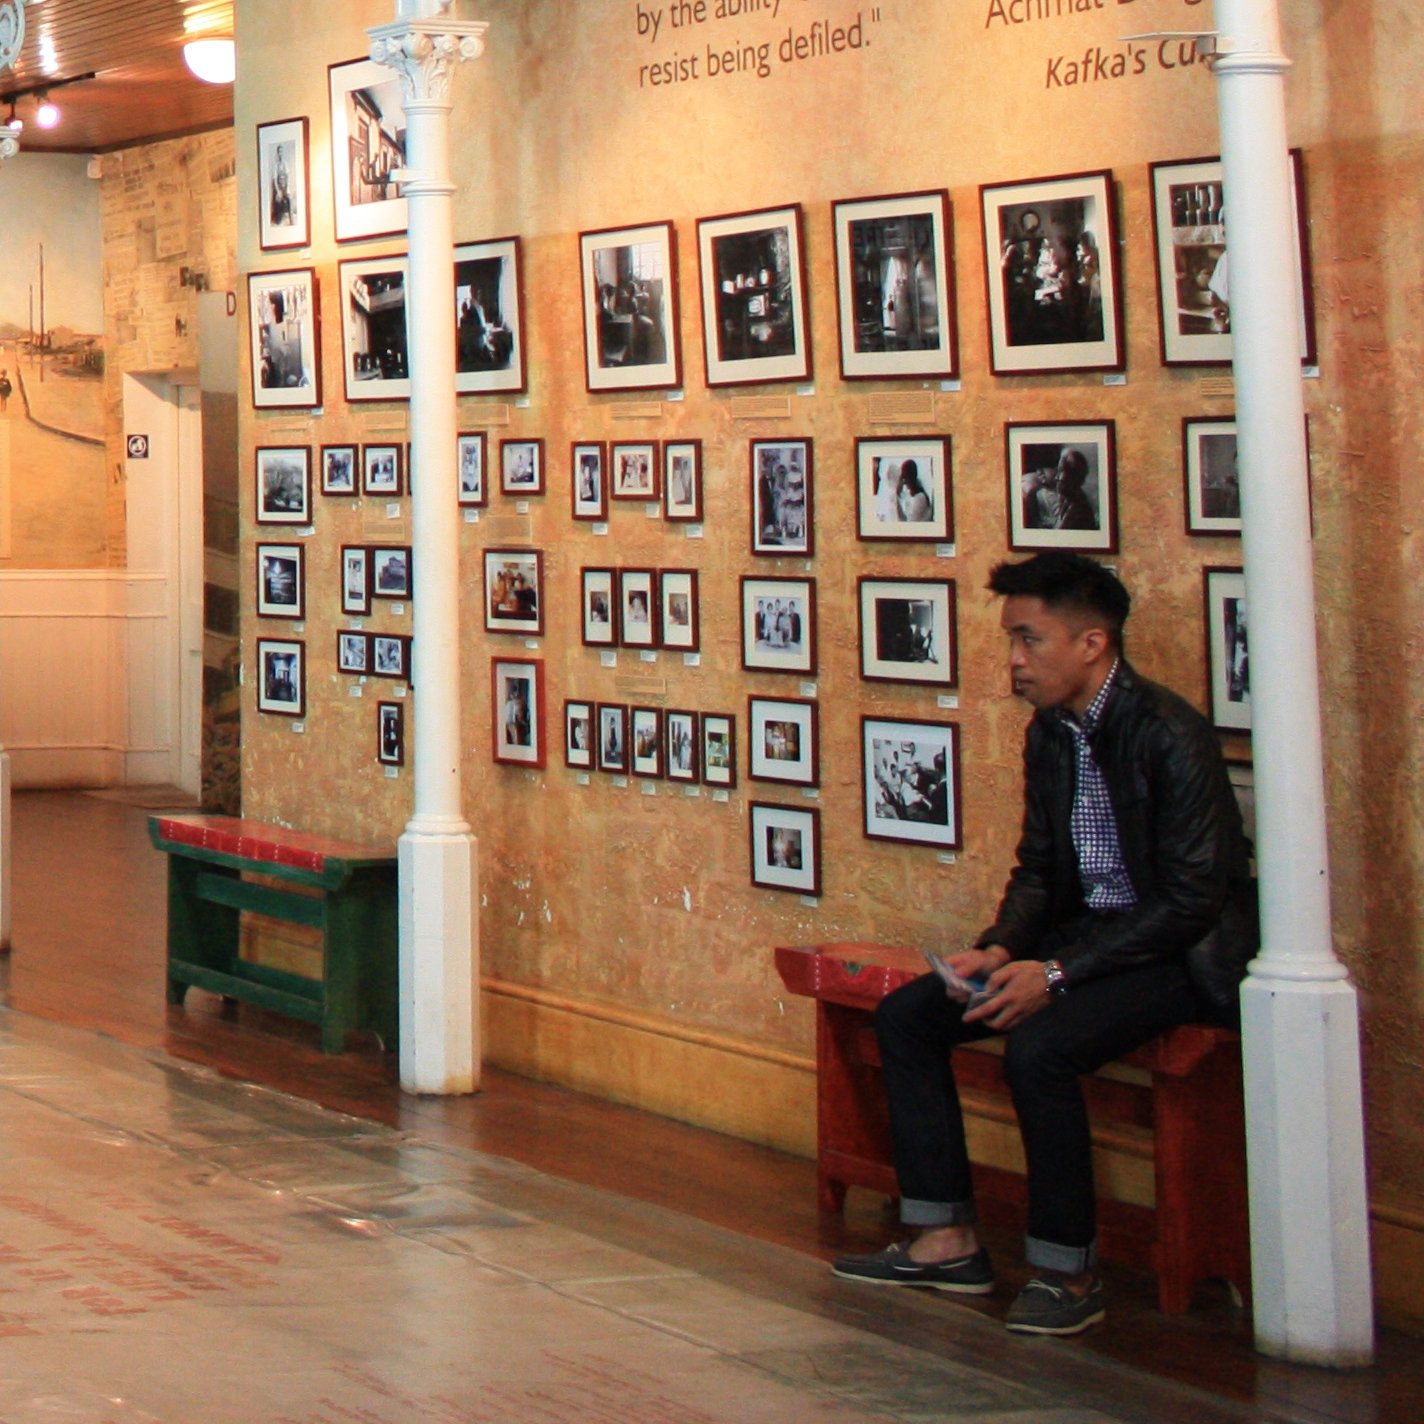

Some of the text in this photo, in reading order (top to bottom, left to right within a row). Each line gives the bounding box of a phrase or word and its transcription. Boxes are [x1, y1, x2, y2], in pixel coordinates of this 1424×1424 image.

[636, 3, 662, 43] by
[639, 6, 882, 89] resist being defiled."
[1045, 44, 1147, 89] Kafka's
